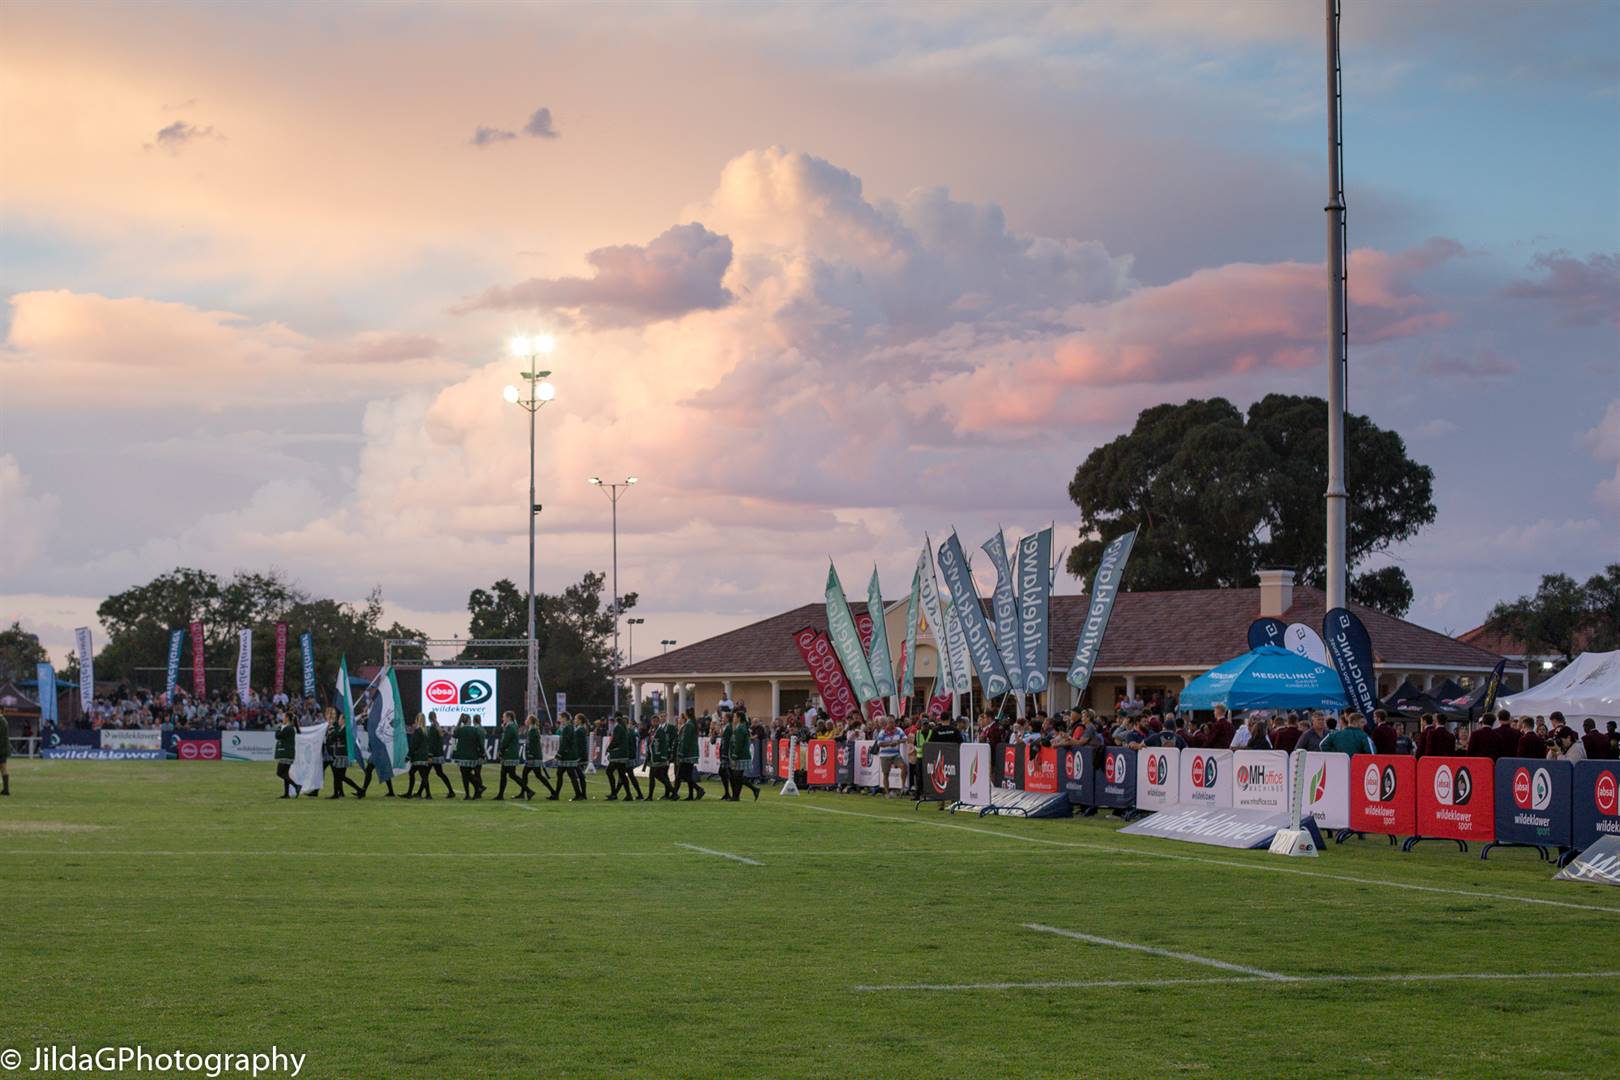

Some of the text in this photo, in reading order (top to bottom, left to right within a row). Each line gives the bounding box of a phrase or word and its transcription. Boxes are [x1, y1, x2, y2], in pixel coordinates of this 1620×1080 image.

[1252, 671, 1316, 679] MEDICLINIC
[49, 750, 160, 759] wildeklawer
[1600, 787, 1613, 797] absa
[1365, 805, 1395, 817] wildeklawer
[1436, 808, 1472, 821] wildeklawer
[1383, 817, 1395, 825] sport
[1514, 813, 1550, 827] wildeklawer
[1458, 821, 1473, 831] sport
